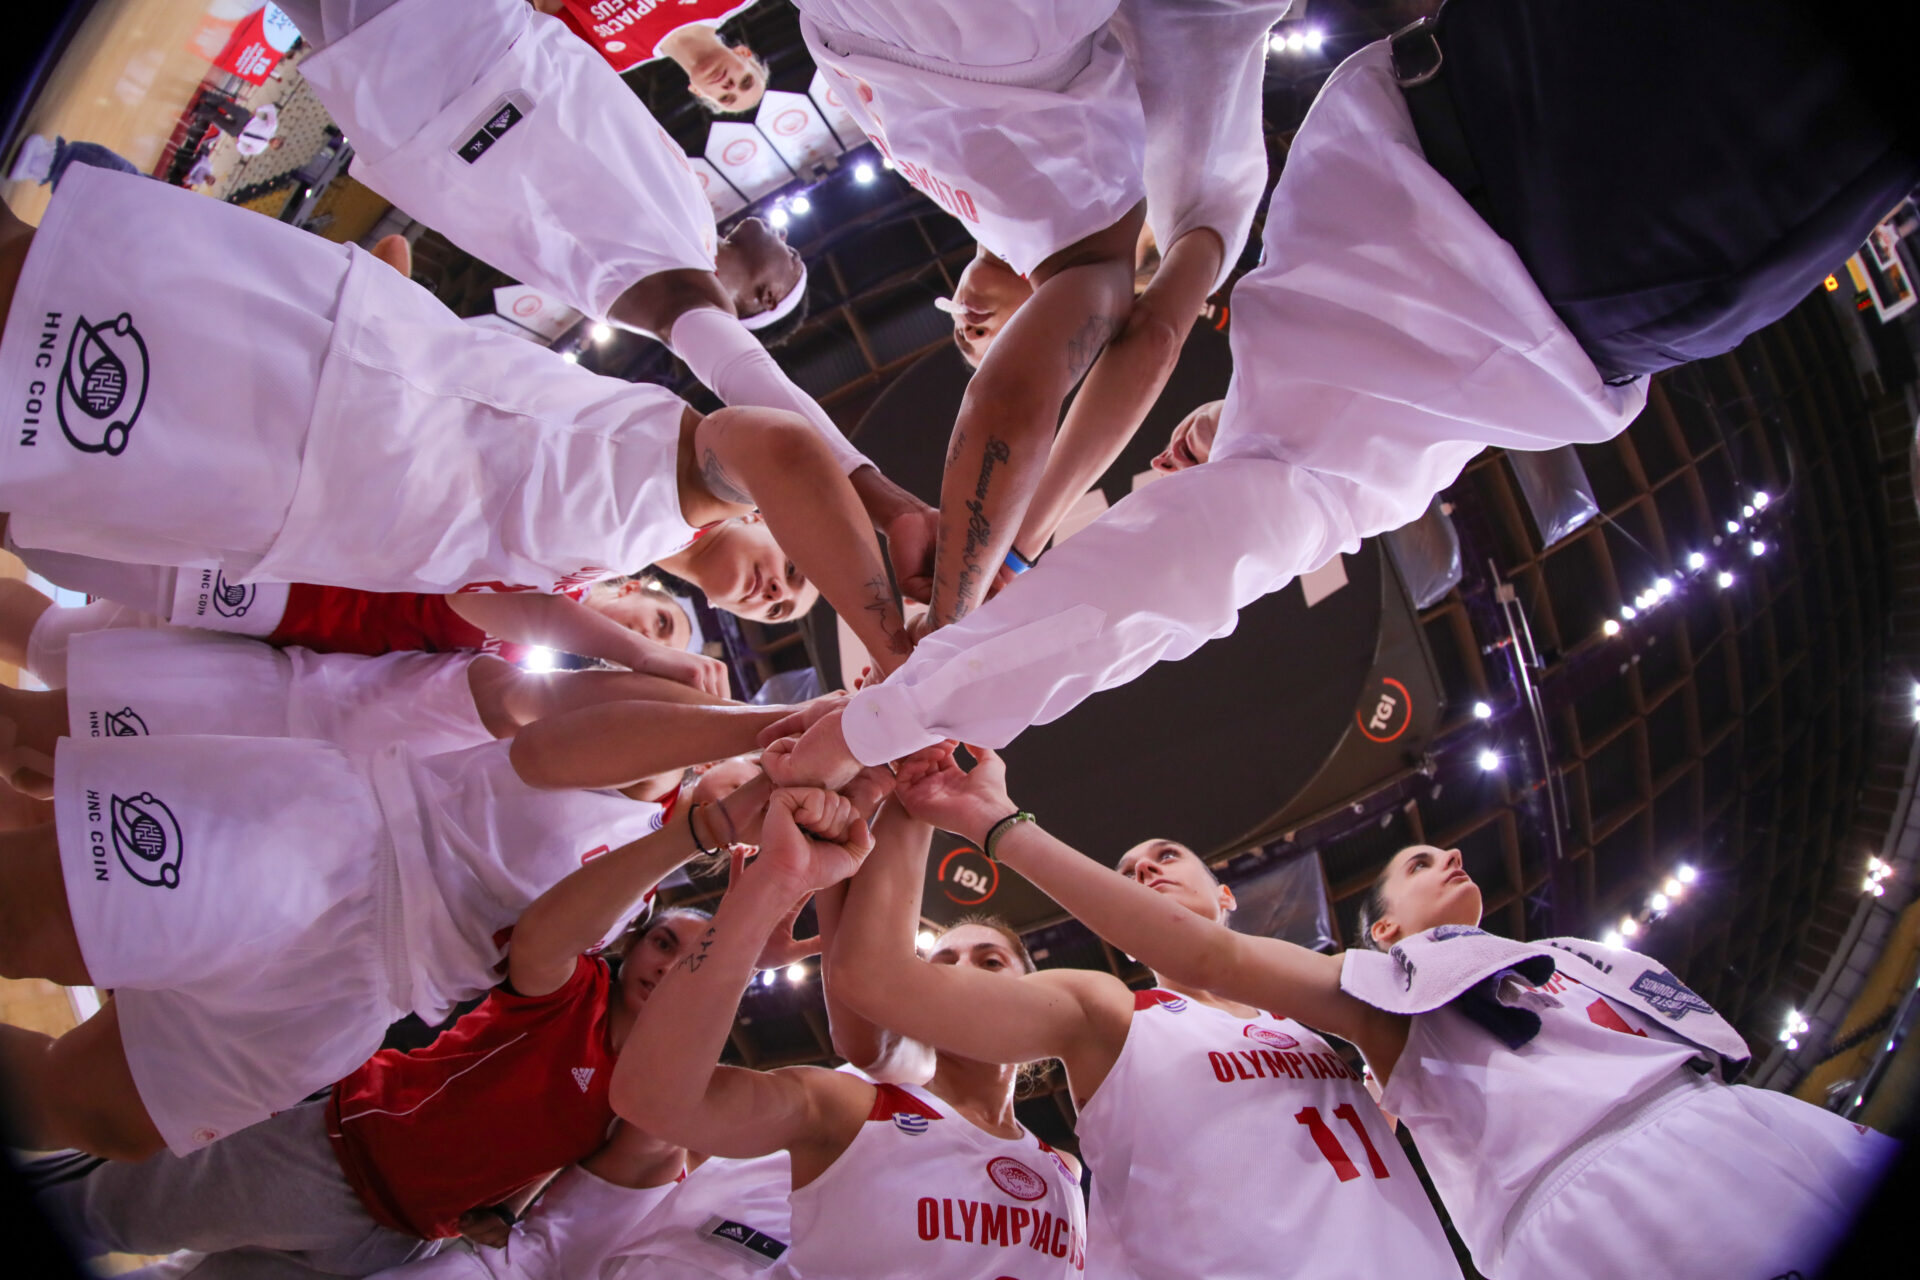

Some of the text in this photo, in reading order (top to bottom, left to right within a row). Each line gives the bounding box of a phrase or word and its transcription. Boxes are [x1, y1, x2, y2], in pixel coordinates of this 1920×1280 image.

[470, 140, 483, 151] XL
[20, 311, 62, 447] HNC COIN
[197, 593, 208, 615] COIN
[89, 710, 99, 737] HNC
[1368, 693, 1397, 733] TGI
[86, 789, 111, 882] HNC COIN
[952, 864, 989, 895] TGI
[1639, 977, 1676, 997] ROUNDS
[1294, 1103, 1391, 1183] 11
